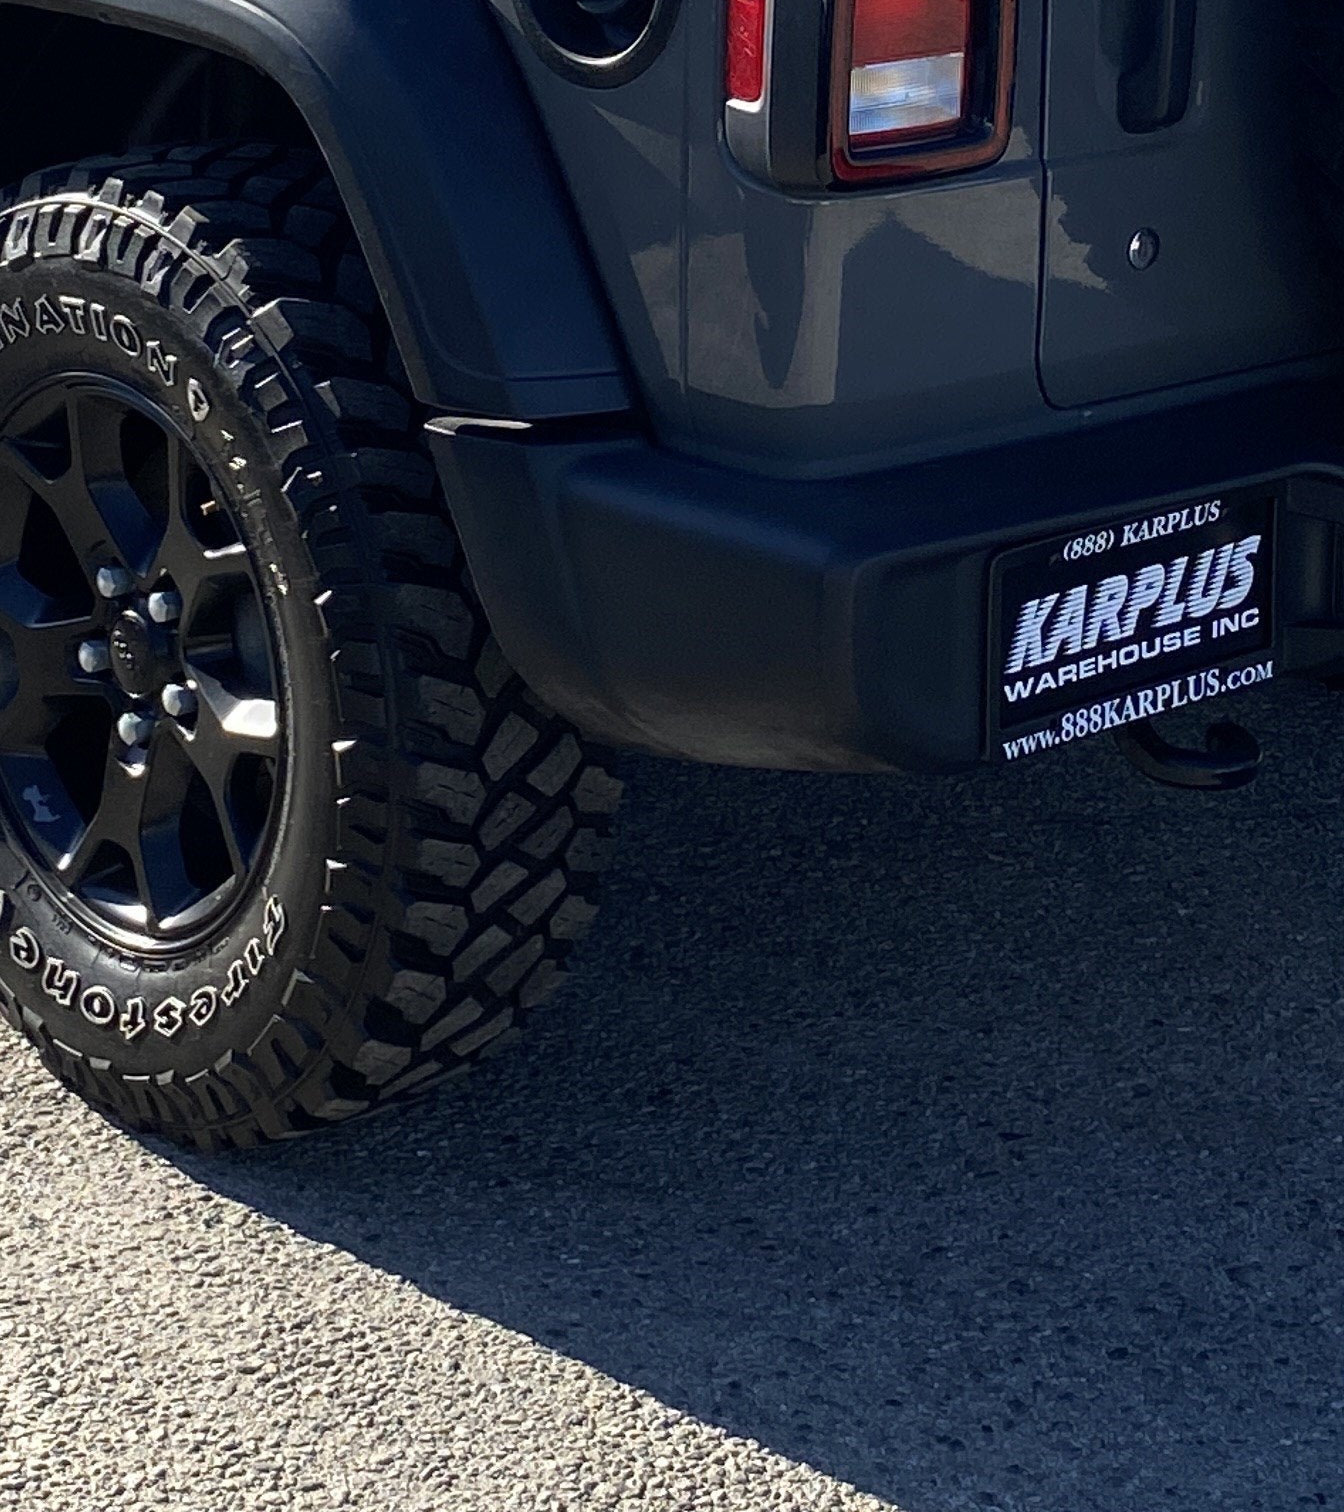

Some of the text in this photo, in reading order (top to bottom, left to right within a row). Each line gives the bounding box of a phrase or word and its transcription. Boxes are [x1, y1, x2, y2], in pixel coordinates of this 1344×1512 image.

[1063, 501, 1221, 561] (888) KARPLUS
[1003, 535, 1262, 675] KARPLUS
[1004, 608, 1260, 702] WAREHOUSE INC
